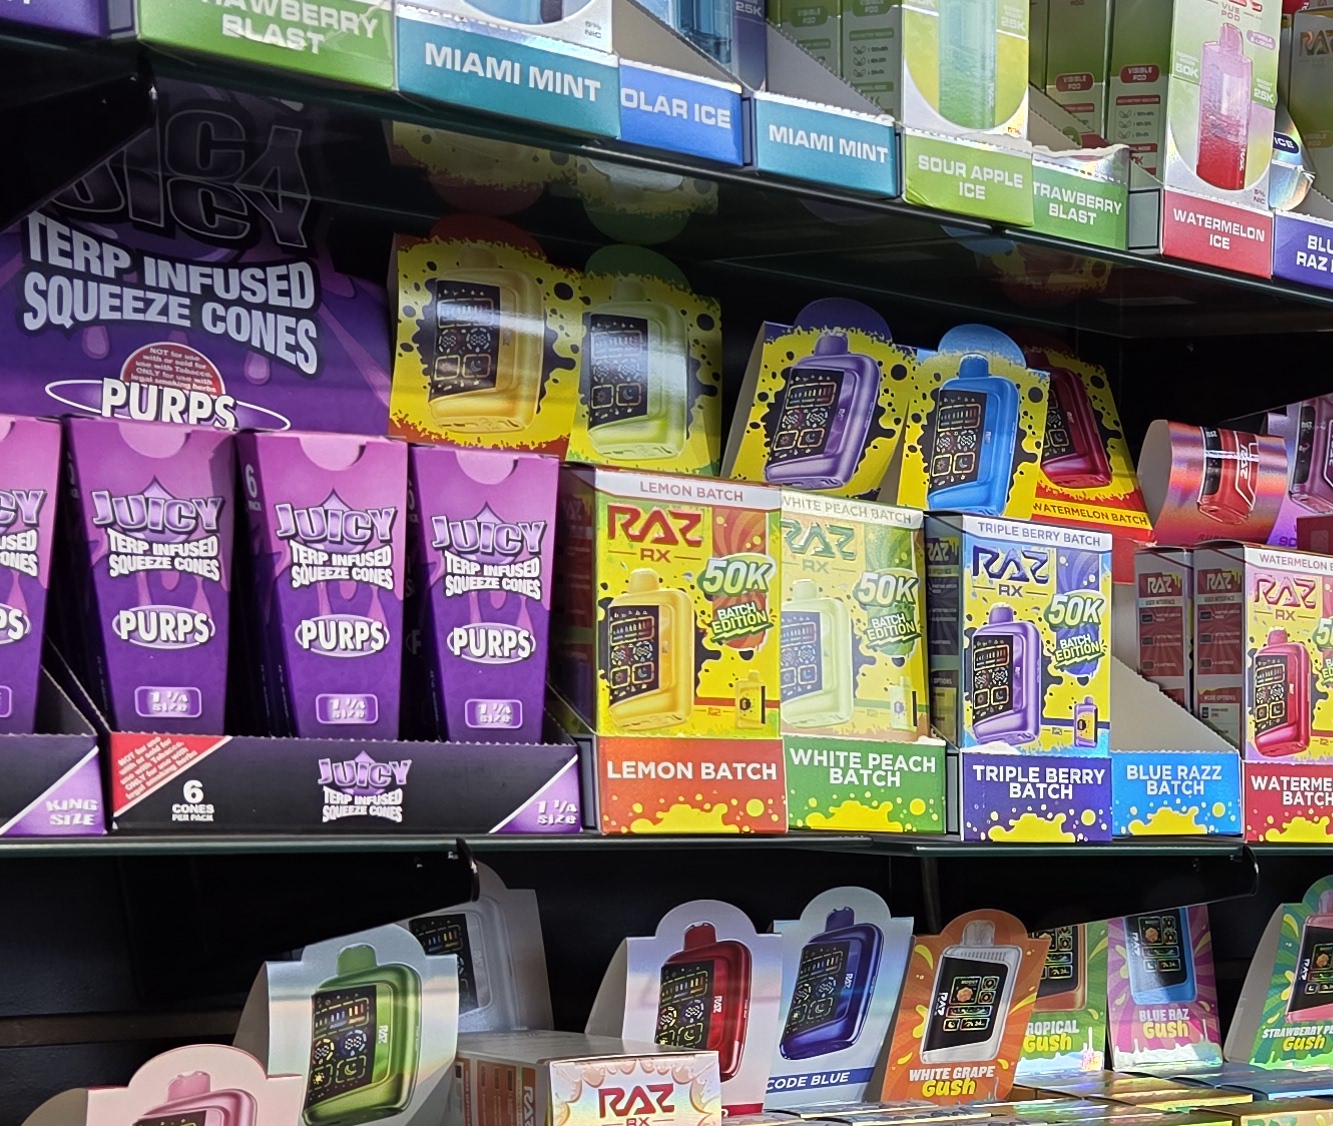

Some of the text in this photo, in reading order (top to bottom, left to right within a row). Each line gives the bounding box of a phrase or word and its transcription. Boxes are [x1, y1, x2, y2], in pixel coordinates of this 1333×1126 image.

[222, 14, 325, 54] BLAST
[425, 44, 601, 103] MIAMI MINT
[621, 87, 731, 129] OLAR ICE
[918, 154, 1023, 188] SOUR APPLE
[959, 182, 985, 201] ICE
[1174, 208, 1265, 242] WATERMELON
[1209, 232, 1230, 250] ICE
[27, 215, 316, 310] TERP INFUSED
[1296, 251, 1328, 272] RAZ
[23, 272, 318, 375] SQUEEZE CONES
[150, 348, 168, 356] NOT
[101, 377, 236, 430] PURPS
[91, 490, 224, 531] JUICY
[607, 503, 702, 547] RAZ
[107, 529, 219, 559] TERP INFUSED
[109, 554, 219, 583] SQUEEZE CONES
[702, 557, 774, 594] 50K
[118, 609, 210, 644] PURPS
[607, 761, 777, 781] LEMON BATCH
[791, 747, 936, 774] WHITE PEACH
[1127, 765, 1222, 781] BLUE RAZZ
[829, 768, 901, 788] BATCH
[973, 766, 1105, 786] TRIPLE BERRY
[1146, 779, 1204, 795] BATCH
[183, 781, 203, 802] 6
[1009, 781, 1073, 800] BATCH
[172, 803, 215, 816] CONES
[190, 813, 213, 822] PACK
